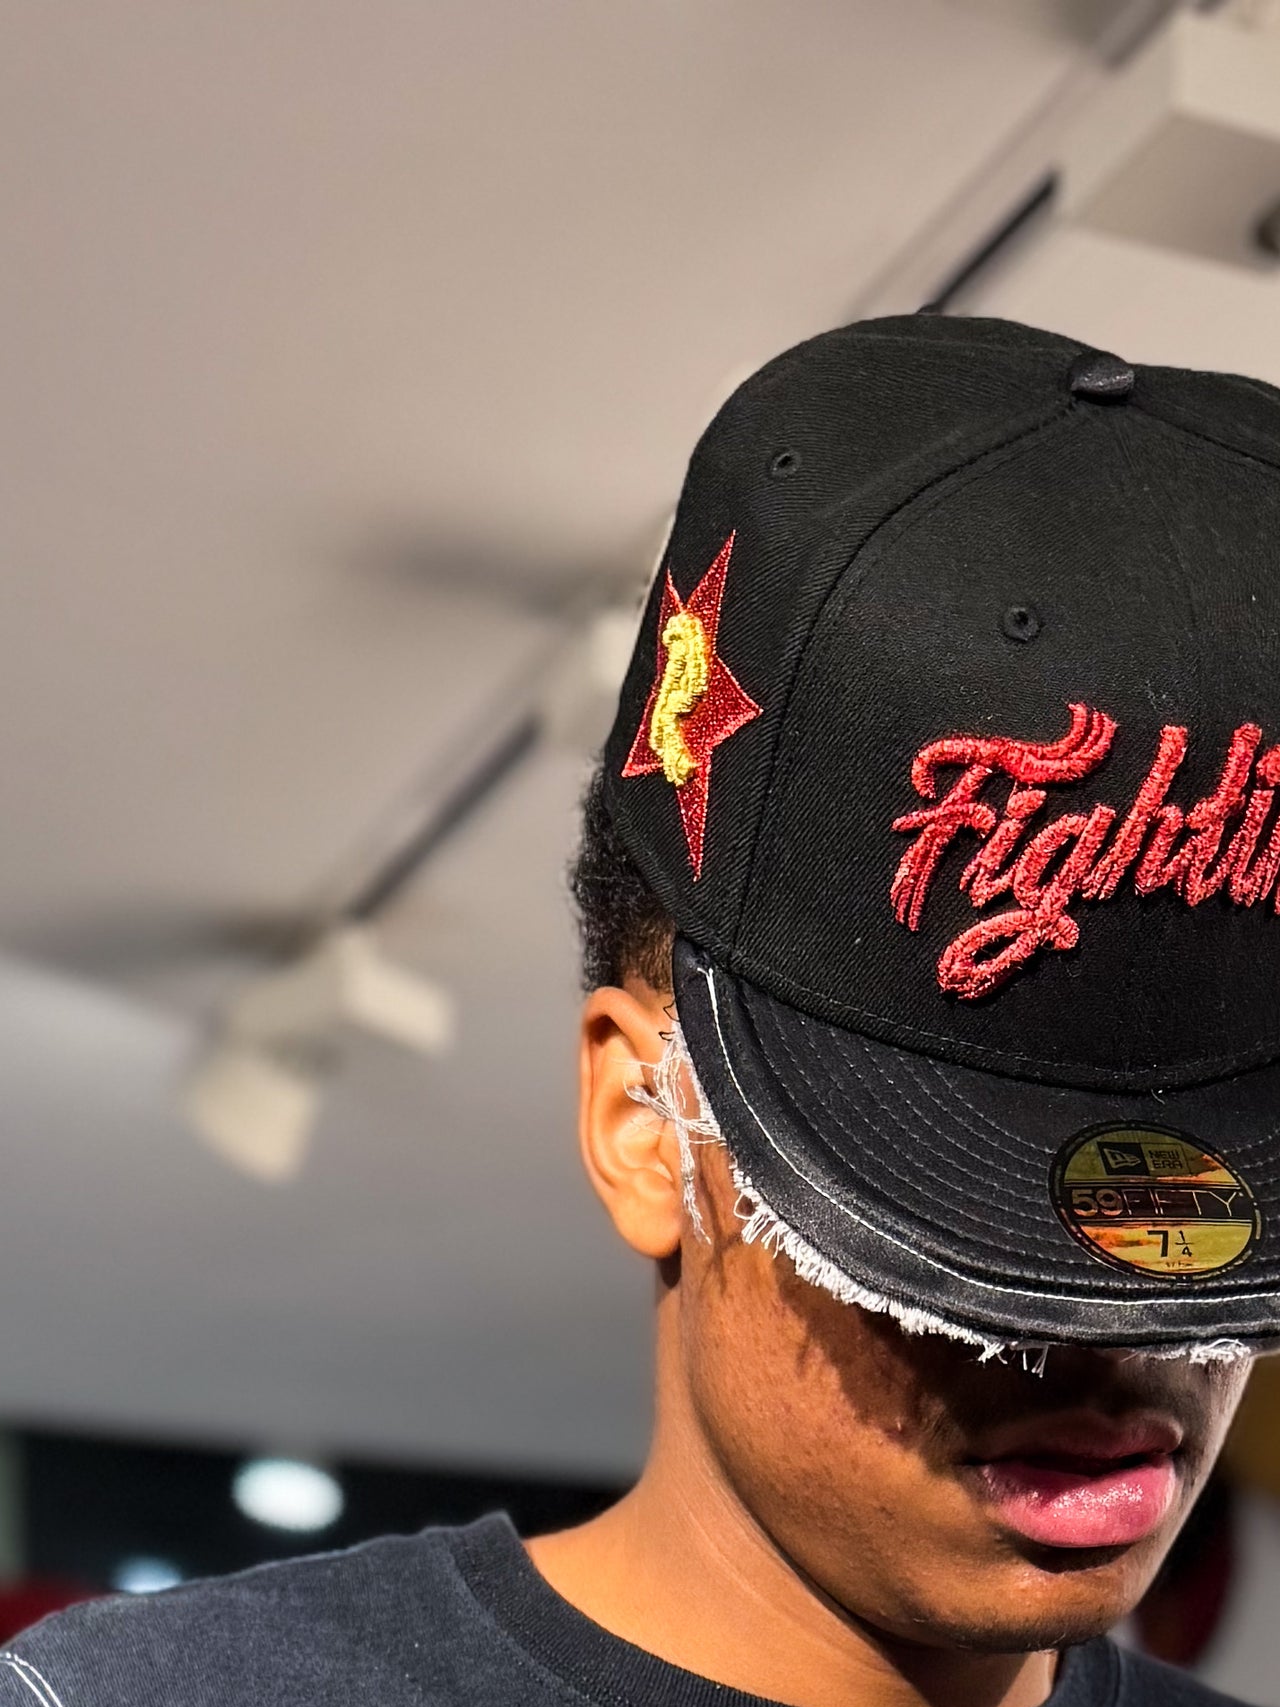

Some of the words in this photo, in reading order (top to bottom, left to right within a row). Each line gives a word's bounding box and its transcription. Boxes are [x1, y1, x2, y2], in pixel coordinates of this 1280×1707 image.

[1148, 1149, 1180, 1160] NEW
[1152, 1160, 1183, 1170] ERA
[1071, 1188, 1238, 1217] 59FIFTY
